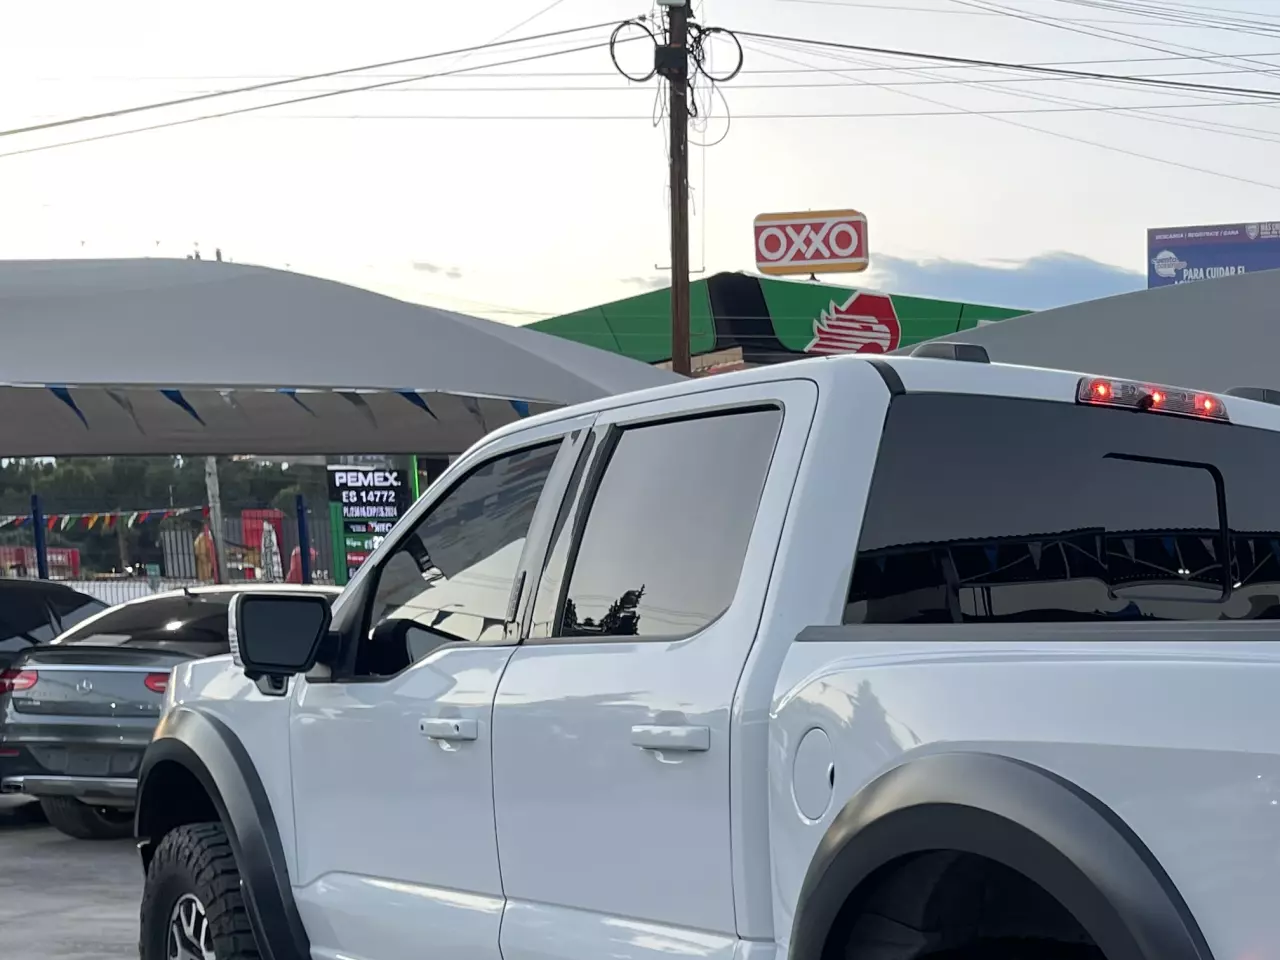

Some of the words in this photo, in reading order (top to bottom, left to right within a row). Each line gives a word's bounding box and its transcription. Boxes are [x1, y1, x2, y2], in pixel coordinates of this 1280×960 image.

[758, 222, 859, 262] OXXO
[1183, 267, 1204, 281] PARA
[1206, 265, 1236, 279] CUIDAR
[335, 472, 398, 487] PEMEX
[360, 490, 396, 503] 14772
